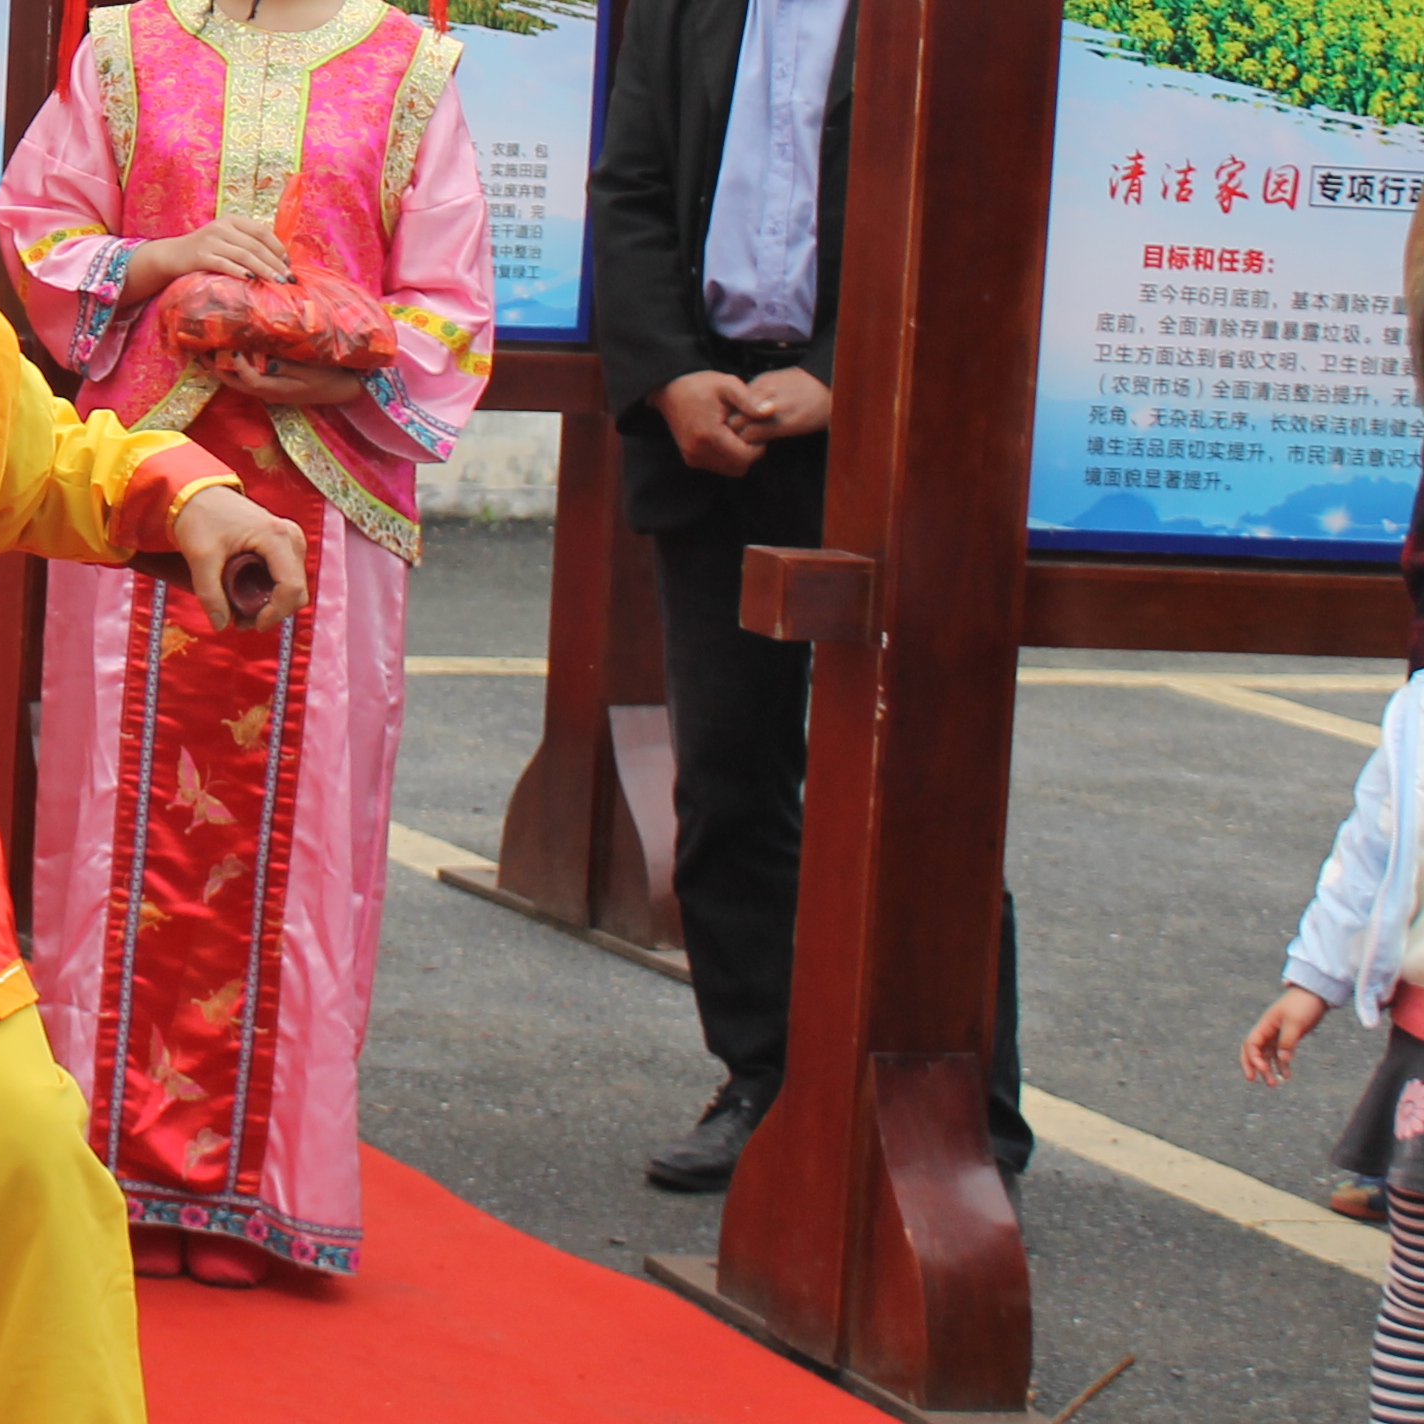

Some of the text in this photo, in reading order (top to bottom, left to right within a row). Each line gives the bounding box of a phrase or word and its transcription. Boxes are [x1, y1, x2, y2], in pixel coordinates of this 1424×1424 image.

[1109, 148, 1301, 214] 清洁家园
[492, 264, 540, 279] 复绿工
[1095, 312, 1414, 346] 底前，全面清除存量暴露垃圾。辖
[1099, 373, 1422, 408] （农贸市场）全面清洁整治提升，无
[1084, 466, 1232, 491] 境面貌显著提升。
